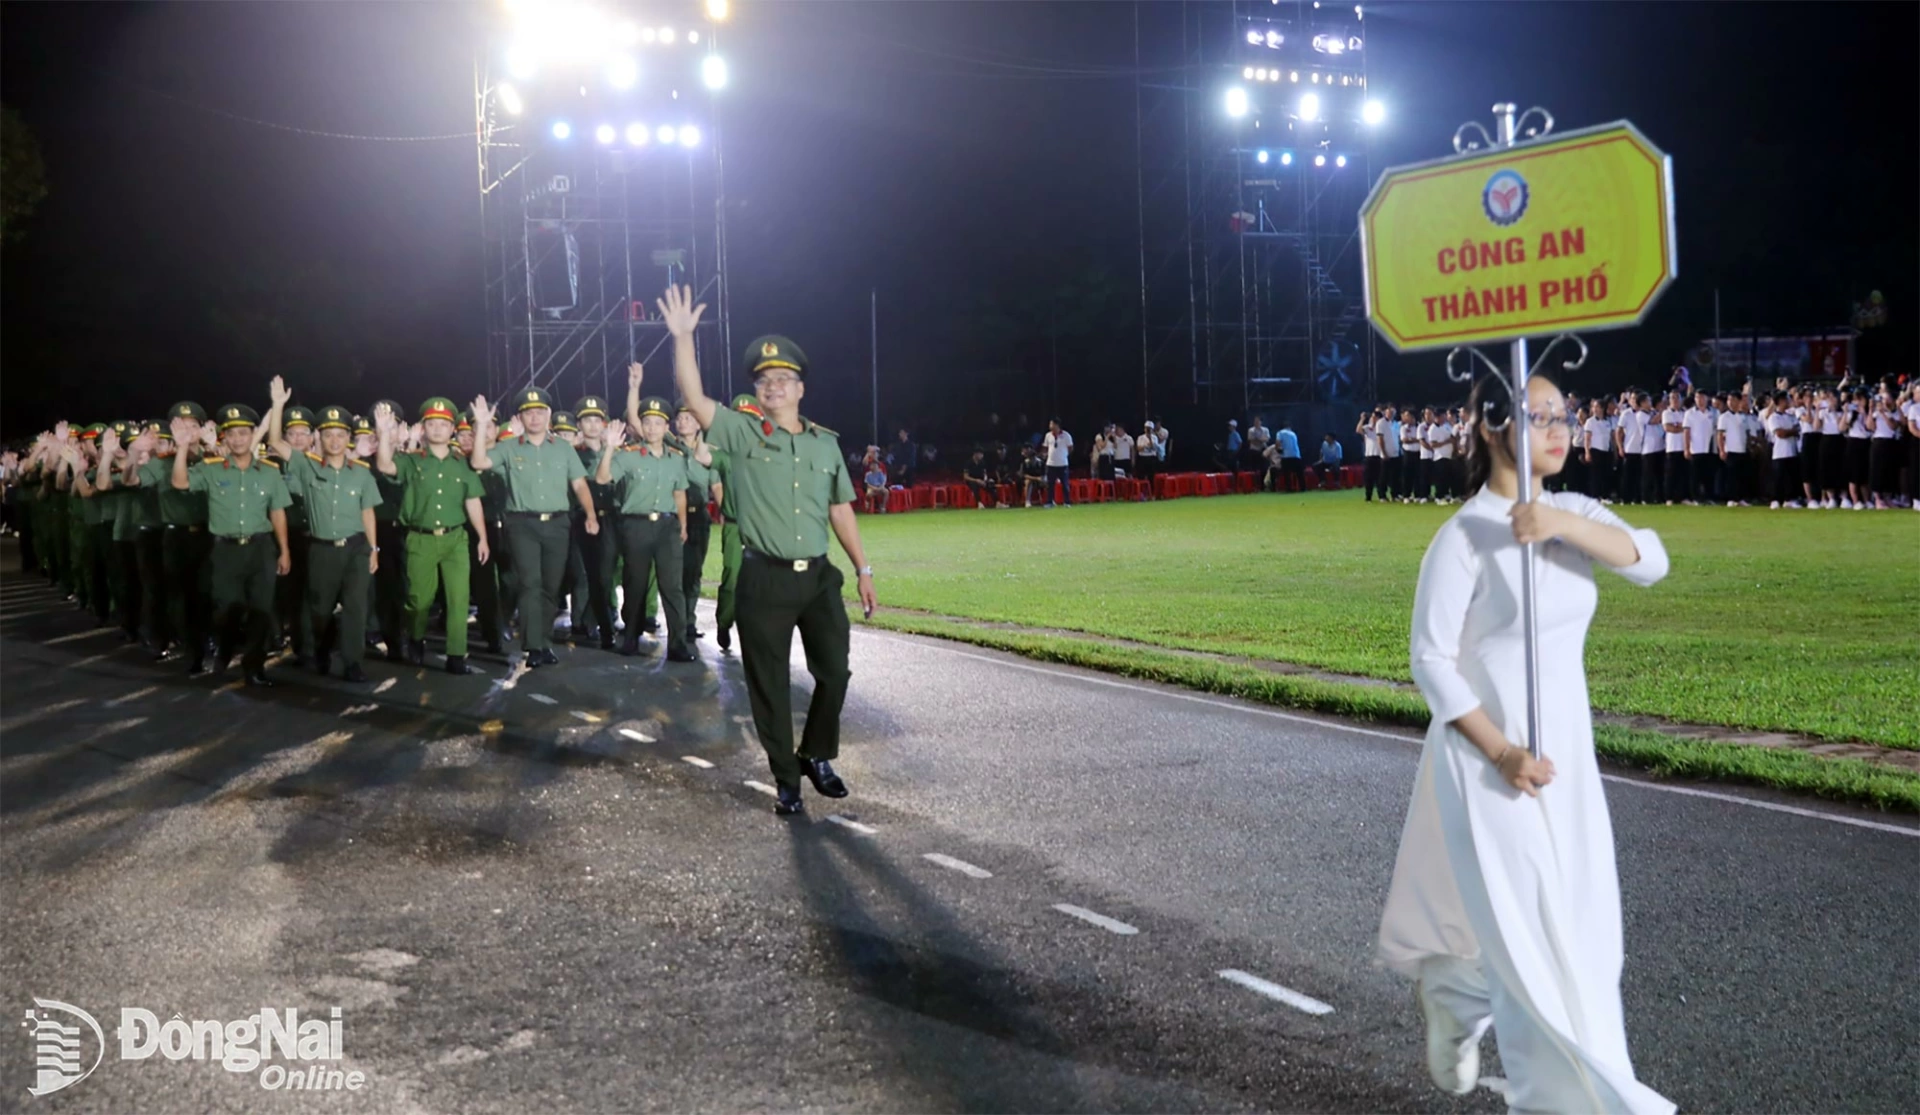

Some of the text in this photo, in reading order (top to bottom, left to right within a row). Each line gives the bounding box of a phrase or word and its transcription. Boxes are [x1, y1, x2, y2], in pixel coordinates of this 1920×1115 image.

[1437, 226, 1585, 275] CÔNG AN
[1422, 260, 1609, 323] THÀNH PHỐ
